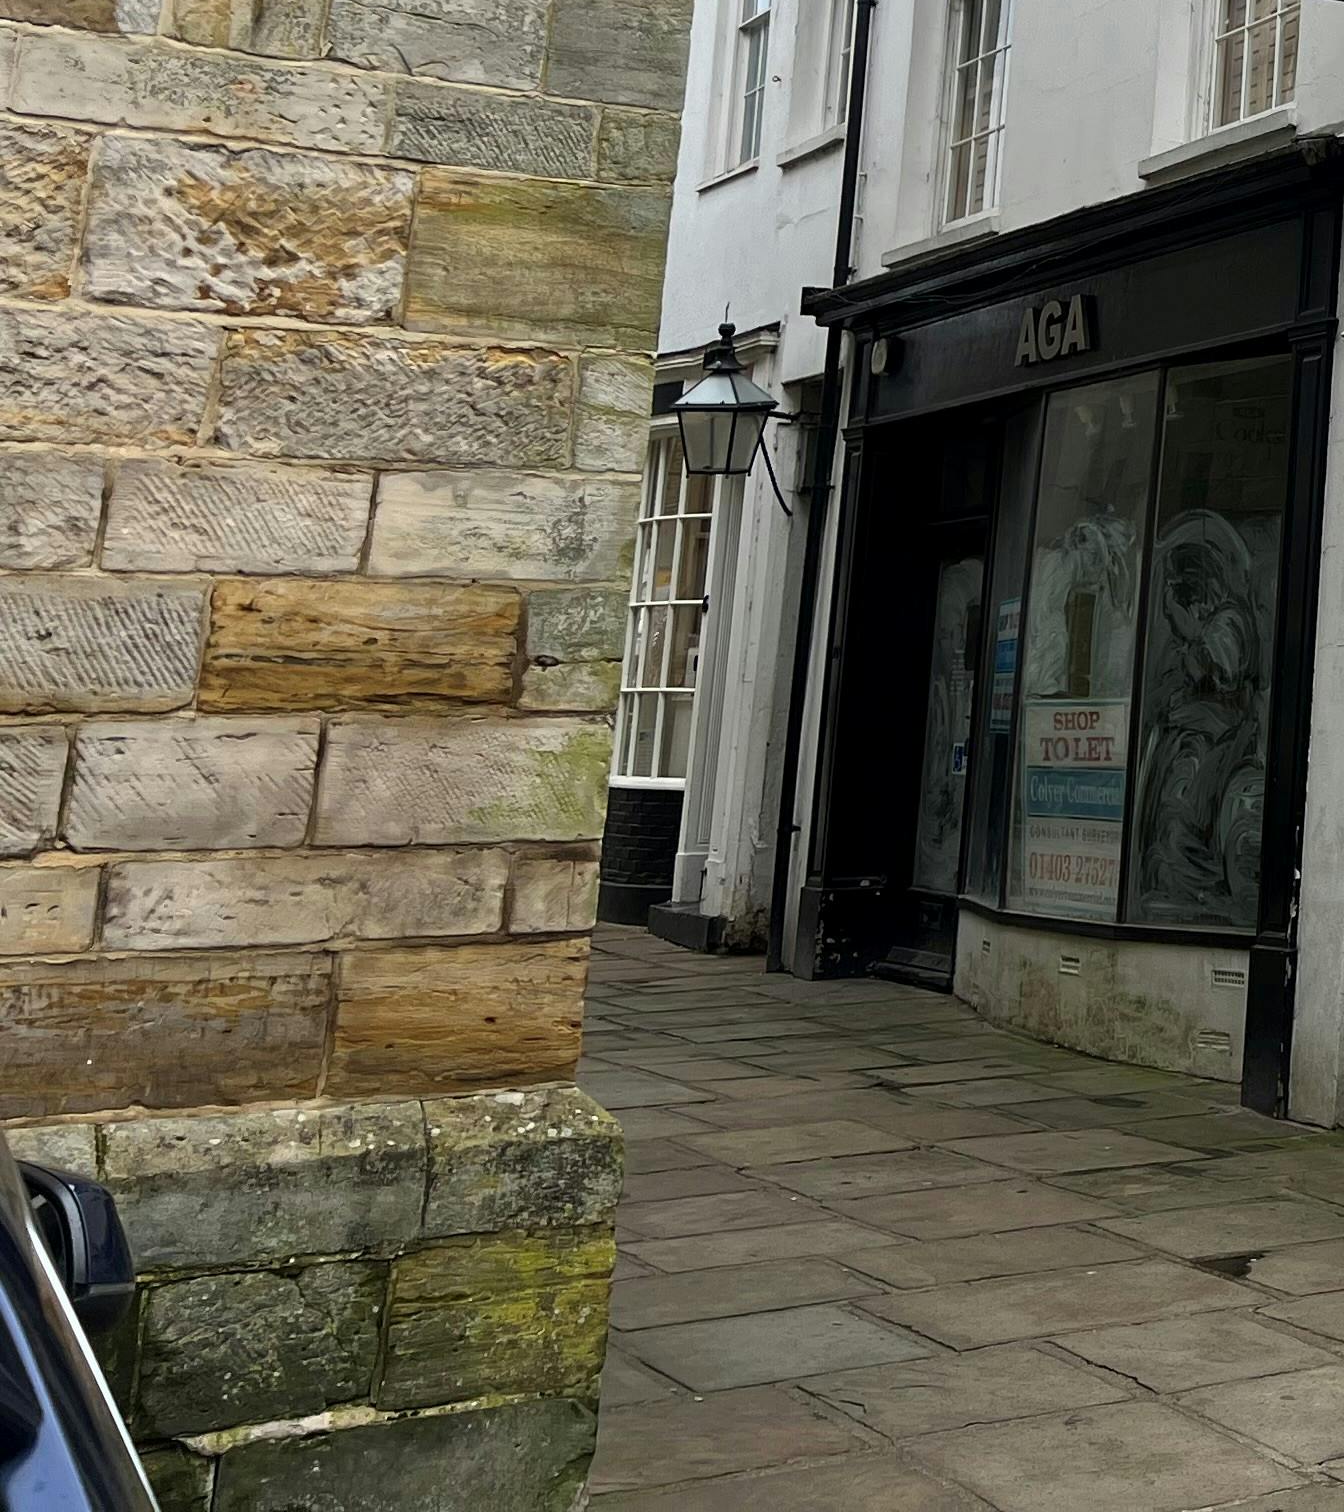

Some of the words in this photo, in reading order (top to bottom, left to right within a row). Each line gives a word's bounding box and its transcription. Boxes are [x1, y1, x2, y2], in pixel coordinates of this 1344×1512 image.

[1015, 293, 1090, 367] AGA
[1053, 711, 1100, 730] SHOP
[1040, 737, 1070, 761] TO
[1072, 736, 1115, 761] LET
[1030, 775, 1064, 808] Colyer
[1029, 852, 1071, 882] 01403
